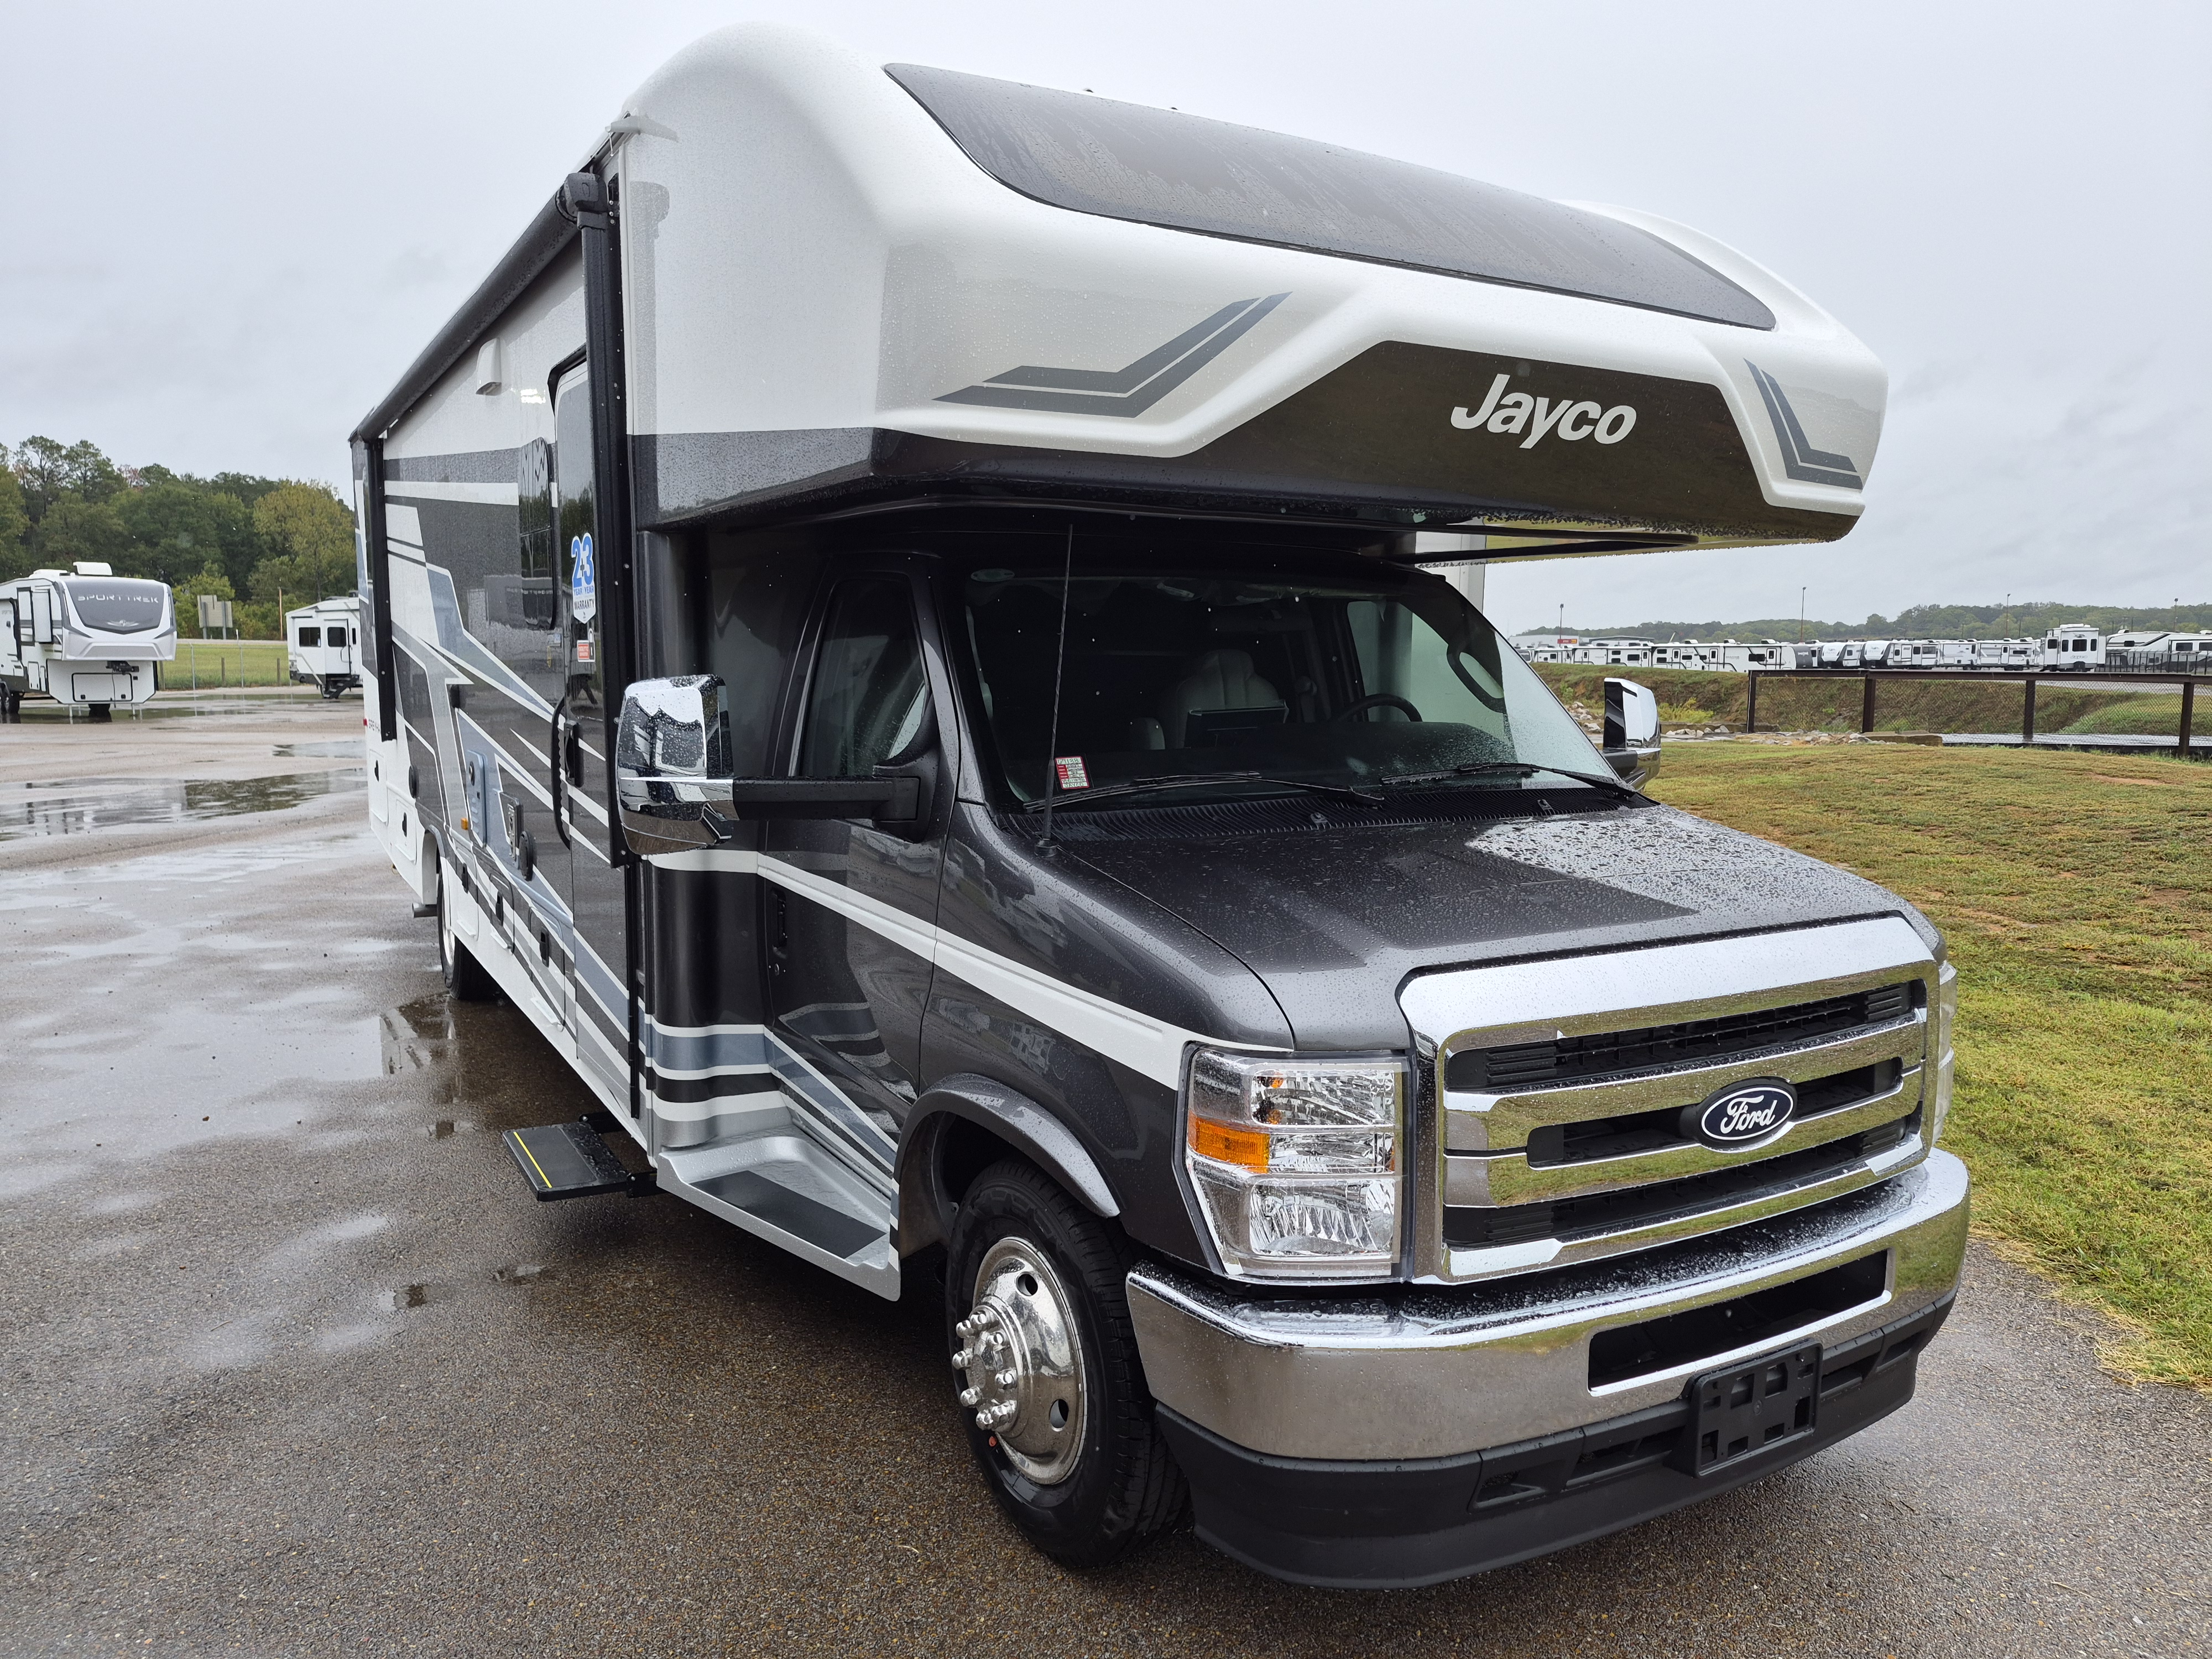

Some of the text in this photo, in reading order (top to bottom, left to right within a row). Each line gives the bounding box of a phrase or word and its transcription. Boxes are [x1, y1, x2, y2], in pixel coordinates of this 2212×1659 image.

[1451, 373, 1637, 449] Jayco
[573, 588, 583, 596] YEAR
[574, 598, 595, 611] WARRANTY
[1720, 1095, 1778, 1134] Ford
